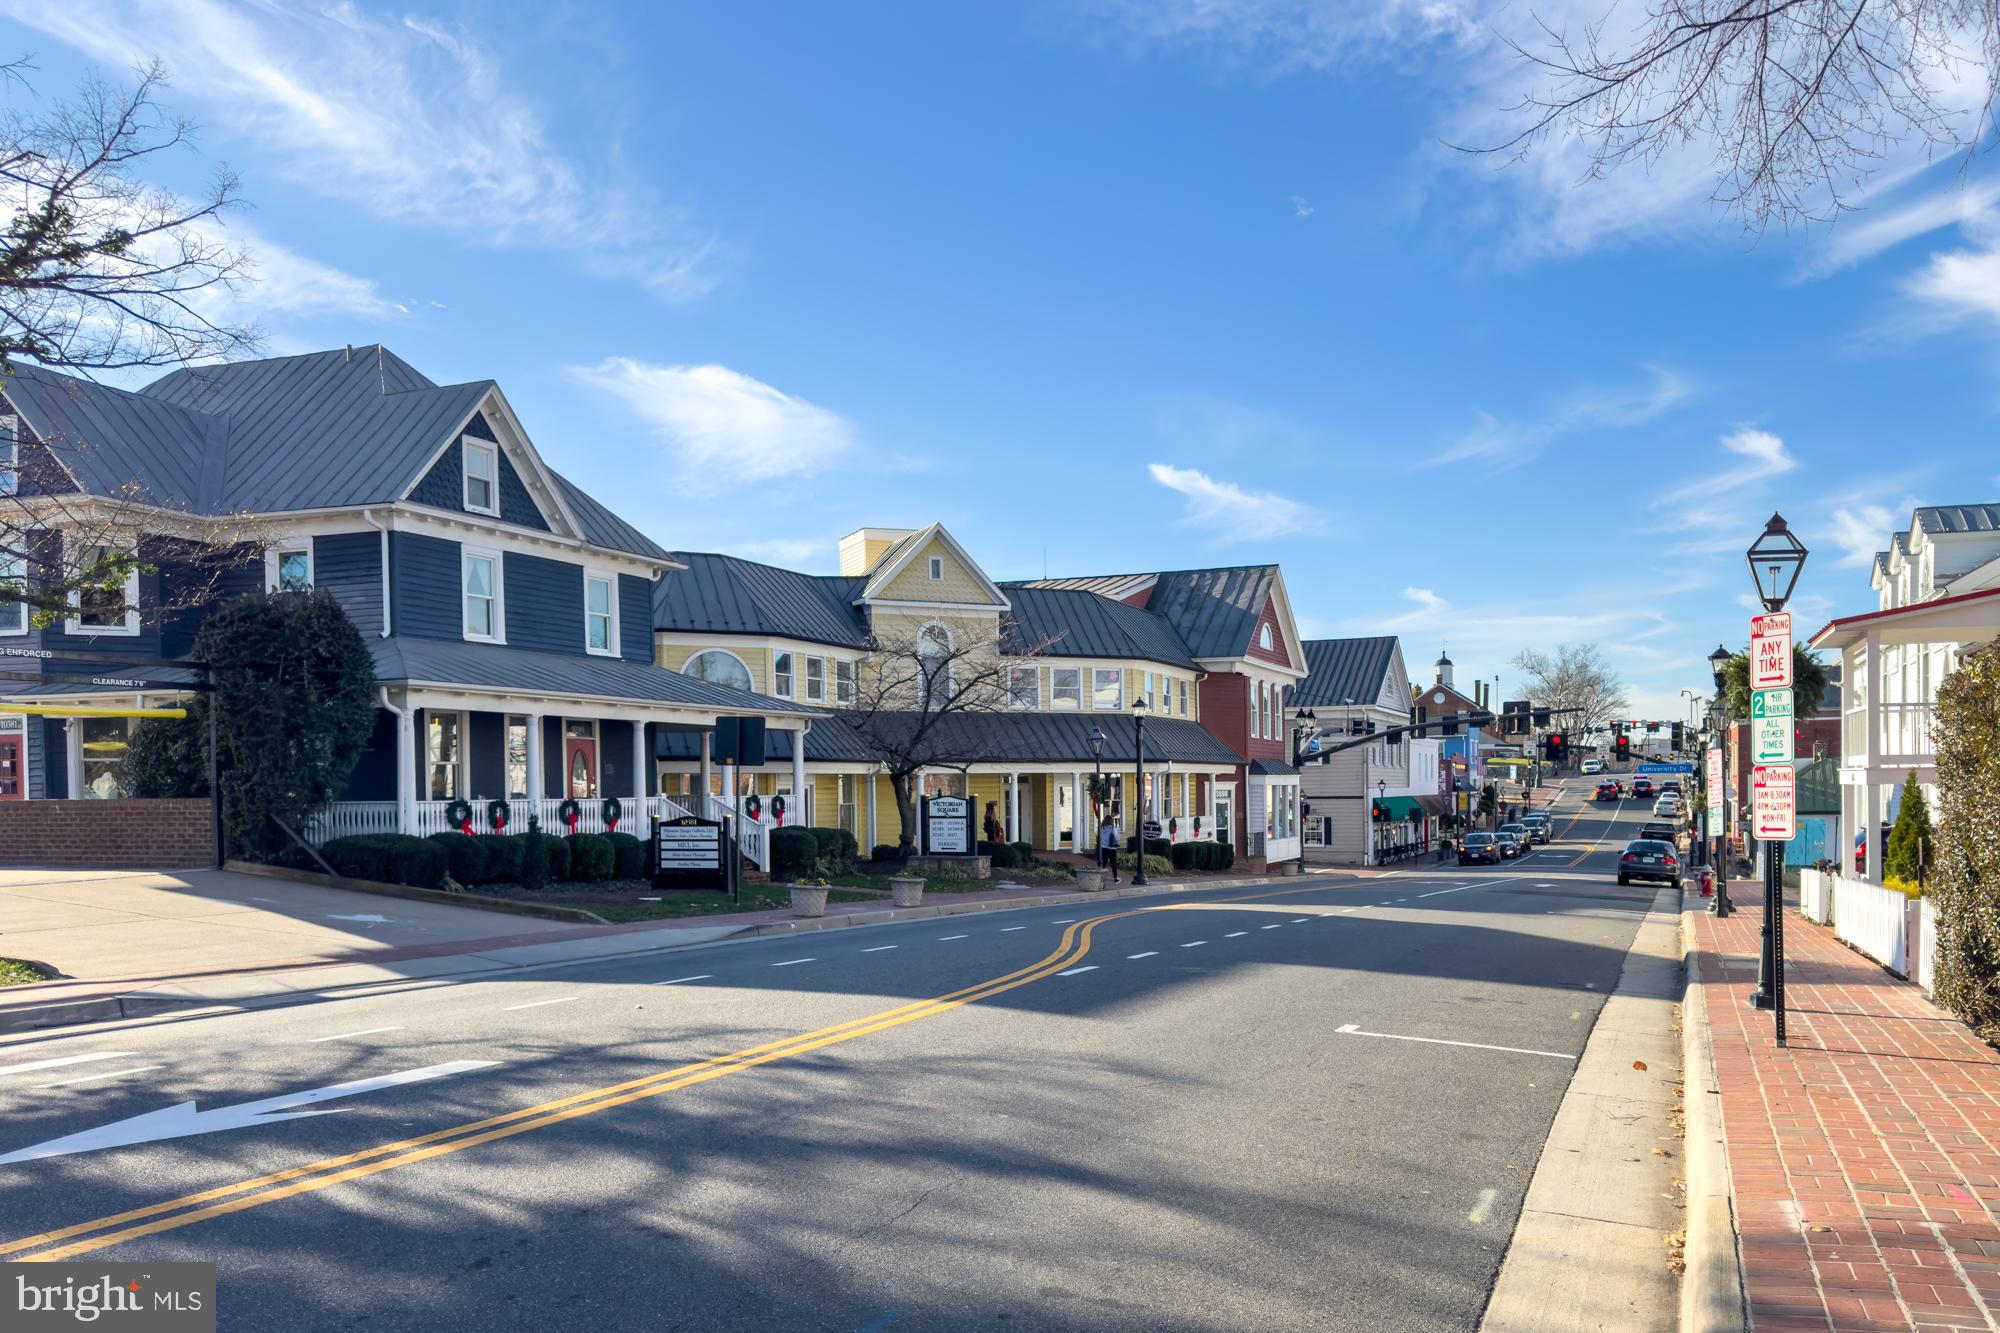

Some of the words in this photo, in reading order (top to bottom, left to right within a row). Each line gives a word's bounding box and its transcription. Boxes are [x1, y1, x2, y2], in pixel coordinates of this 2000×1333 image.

[1752, 620, 1763, 635] NO
[1764, 619, 1788, 632] PARKING
[6, 648, 52, 658] ENFORCED
[1761, 641, 1782, 656] ANY
[1759, 657, 1784, 673] TIME
[92, 678, 134, 687] CLEARANCE
[1754, 696, 1763, 714] 2
[1772, 693, 1782, 702] HR
[1766, 704, 1790, 715] PARKING
[1766, 720, 1780, 728] ALL
[1761, 730, 1784, 739] OTHER
[1763, 740, 1784, 749] TIMES
[1755, 770, 1766, 784] NO
[1767, 772, 1792, 782] PARKING
